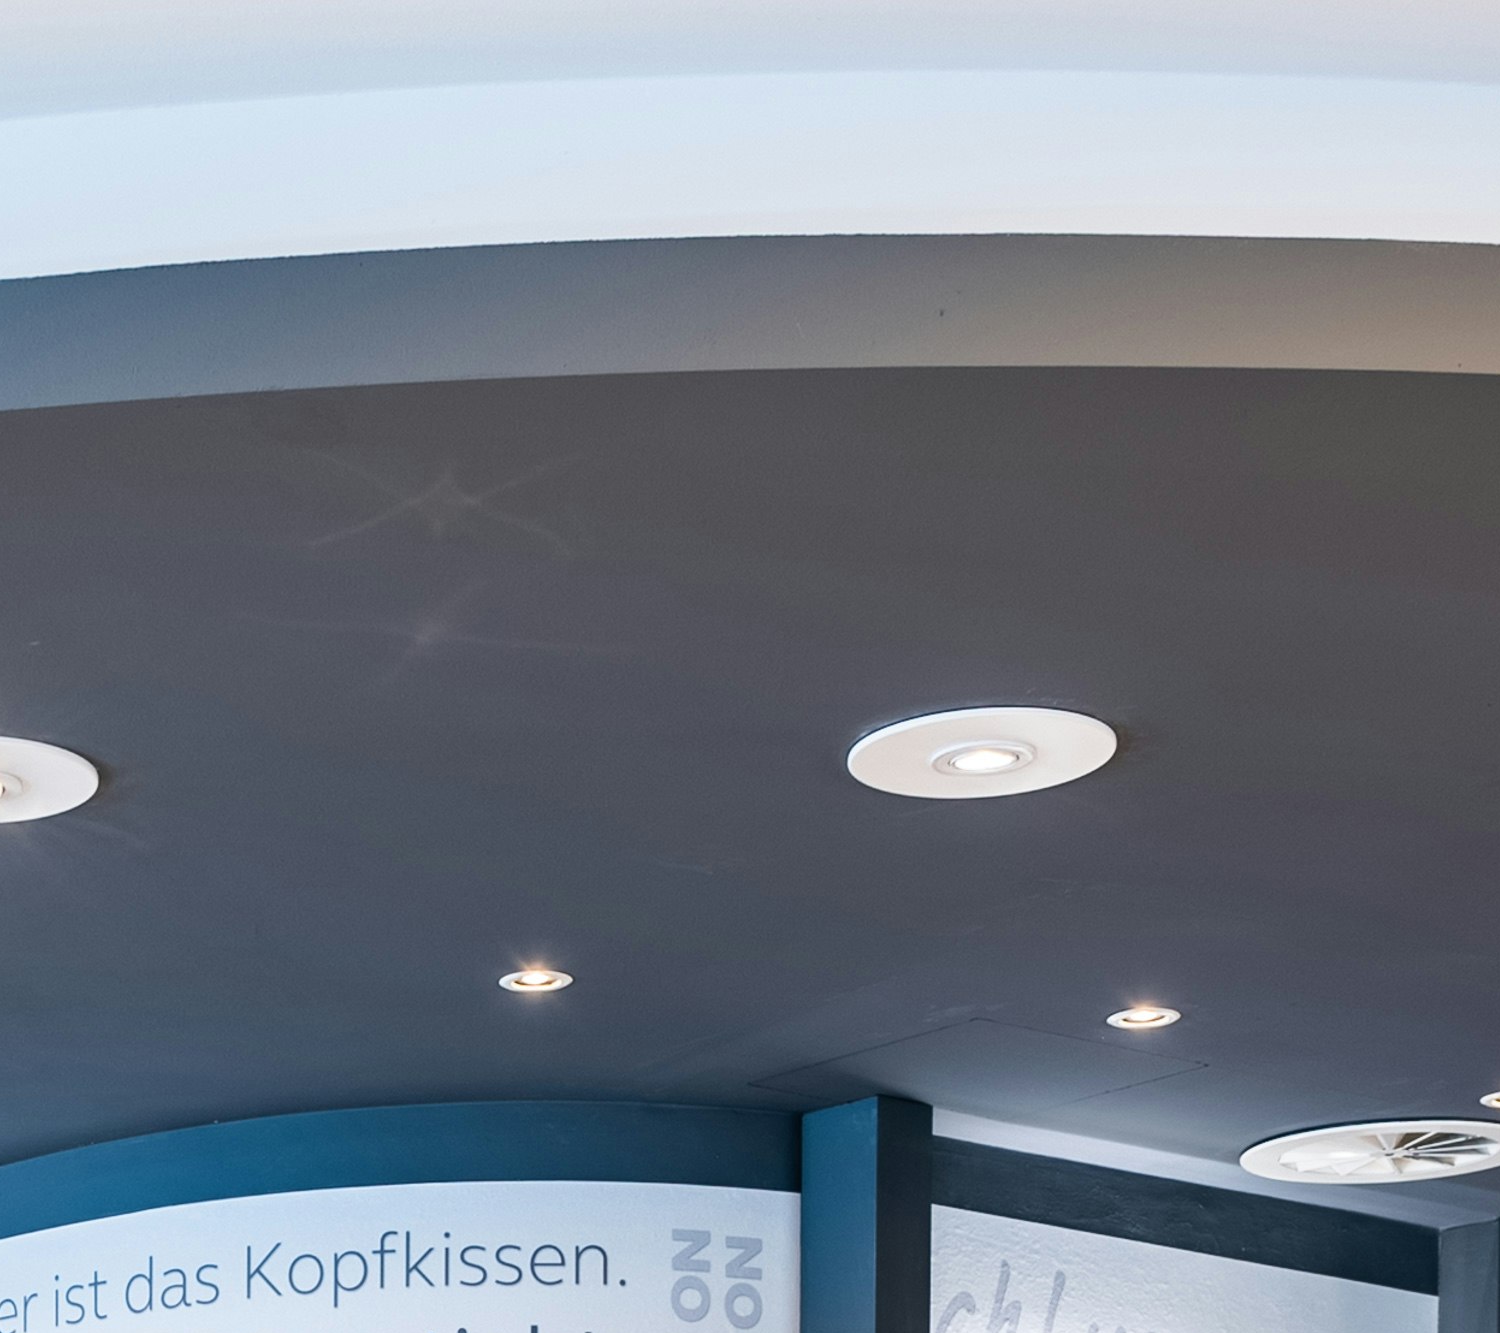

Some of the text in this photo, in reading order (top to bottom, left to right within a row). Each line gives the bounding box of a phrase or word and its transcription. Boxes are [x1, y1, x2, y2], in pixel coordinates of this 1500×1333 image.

[54, 1271, 107, 1327] ist
[125, 1256, 220, 1313] das
[245, 1230, 627, 1308] Kopfkissen.
[671, 1228, 711, 1323] ON
[725, 1235, 763, 1330] ON
